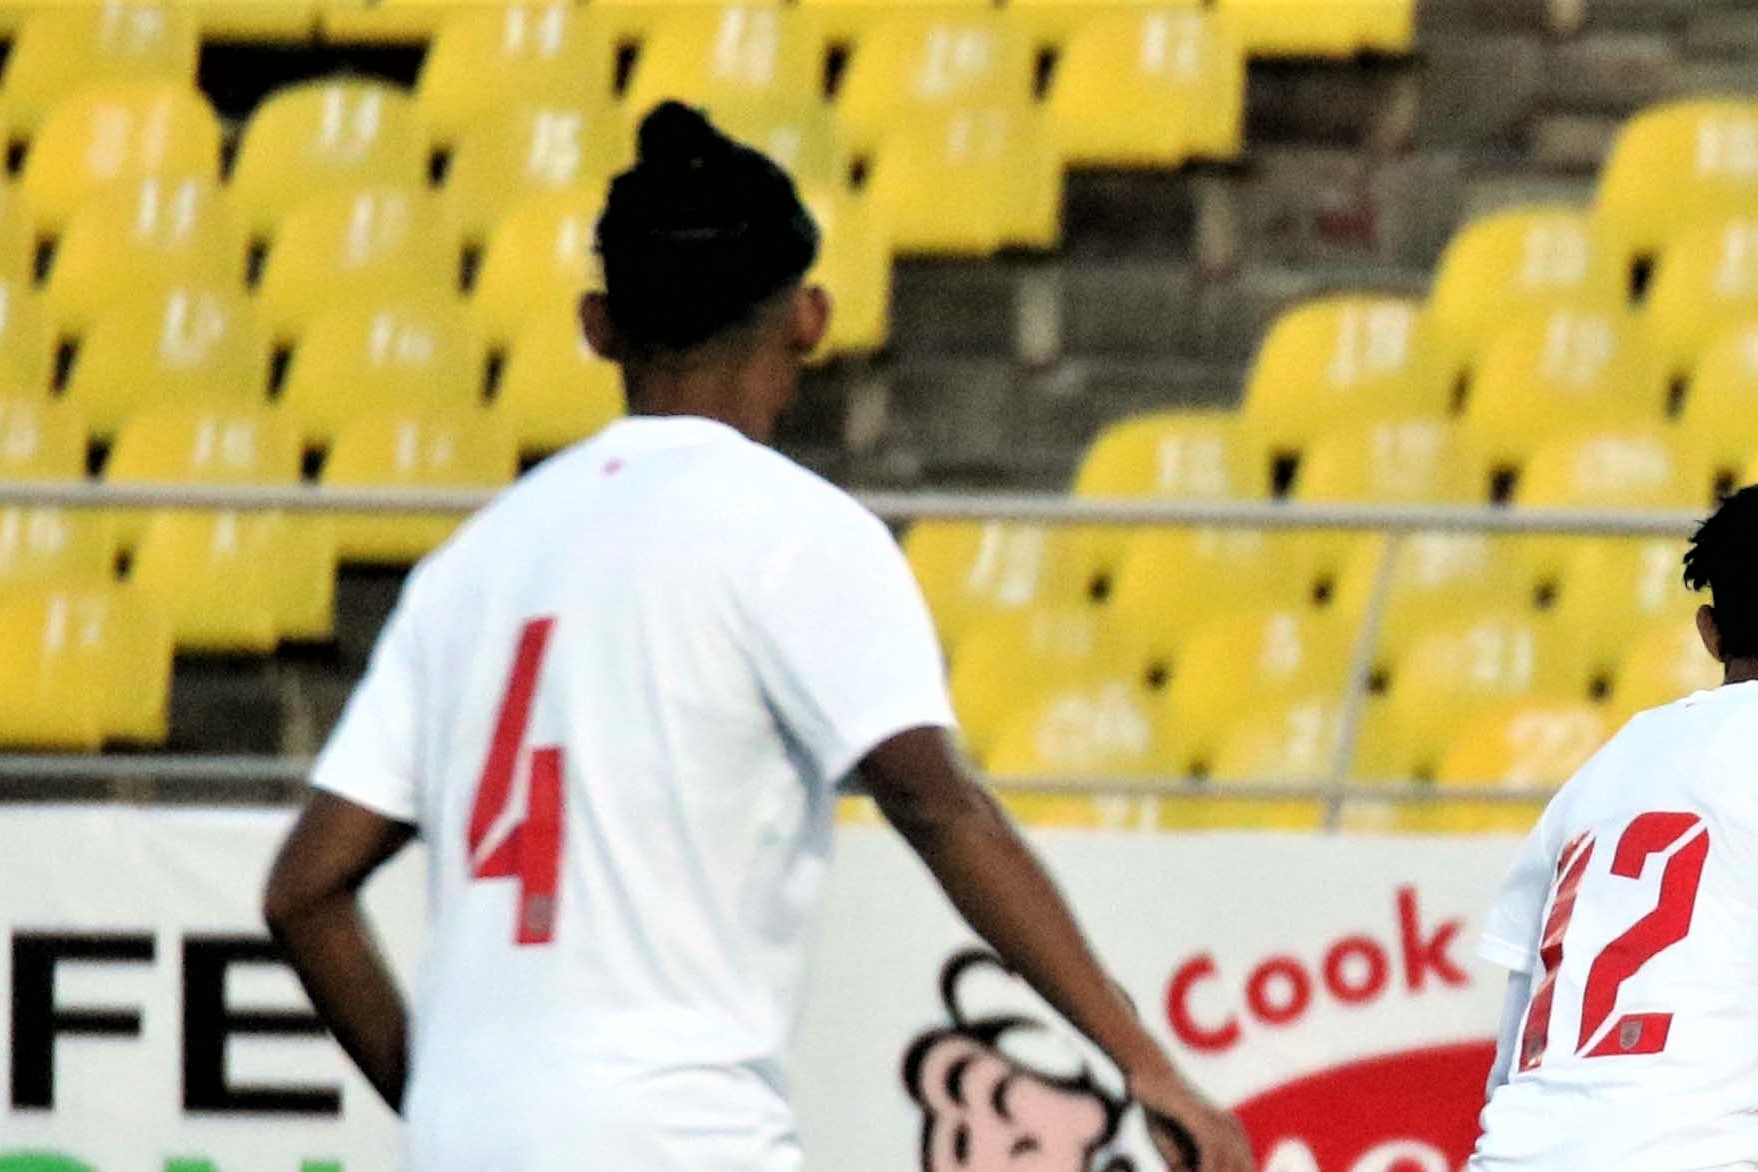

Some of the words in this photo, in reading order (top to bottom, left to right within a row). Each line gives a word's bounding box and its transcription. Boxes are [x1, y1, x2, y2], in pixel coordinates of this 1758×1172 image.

[468, 616, 564, 944] 4
[11, 930, 343, 1116] FE
[1163, 885, 1470, 1054] Cook
[1518, 811, 1710, 1073] 12
